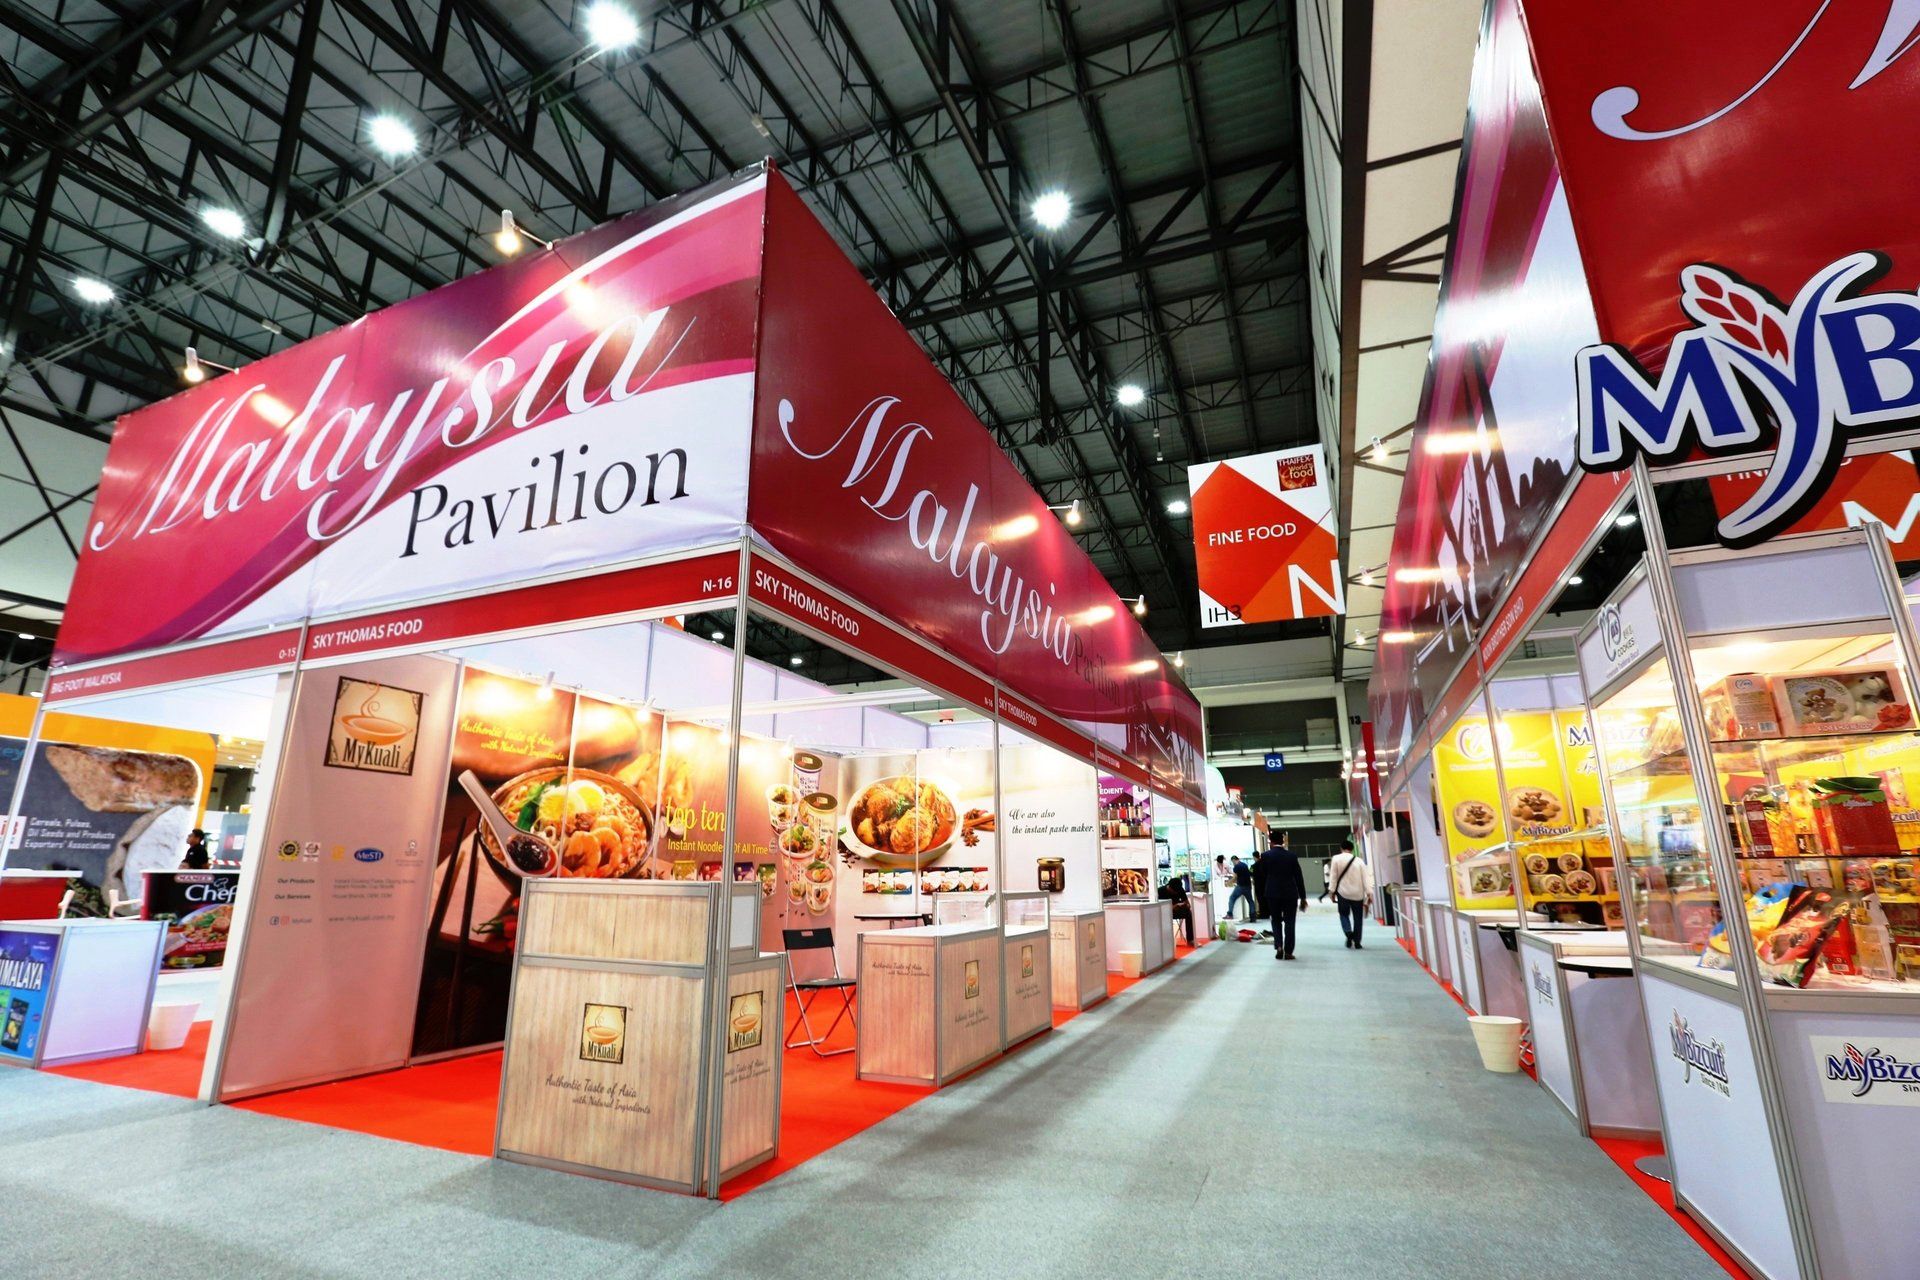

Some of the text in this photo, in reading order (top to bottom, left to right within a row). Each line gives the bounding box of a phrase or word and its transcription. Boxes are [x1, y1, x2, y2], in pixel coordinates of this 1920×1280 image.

[90, 305, 697, 552] Malaysia
[1290, 467, 1313, 479] food
[399, 444, 690, 559] Pavilion
[778, 395, 1074, 665] Malaysia
[1208, 522, 1297, 546] FINE FOOD
[702, 576, 732, 593] N-16
[1288, 559, 1346, 619] N
[755, 569, 859, 636] SKY THOMAS FOOD
[1208, 604, 1243, 623] IH3
[313, 618, 423, 650] SKY THOMAS FOOD
[51, 671, 122, 694] BIG FOOT MALAYSIA
[1007, 702, 1026, 721] THOMAS
[1025, 712, 1038, 727] FOOD
[343, 737, 401, 768] MyKuali
[1266, 758, 1282, 768] G3
[666, 796, 726, 841] top ten
[1009, 808, 1025, 820] We
[1041, 809, 1055, 818] also
[66, 830, 80, 838] and
[82, 830, 116, 839] Products
[1012, 823, 1094, 835] the instant paste maker.
[67, 840, 111, 849] Association
[668, 839, 696, 851] Instant
[697, 841, 725, 852] Noodle
[742, 844, 751, 853] All
[752, 844, 769, 855] Time
[587, 1040, 616, 1059] MyKuali
[546, 1073, 637, 1098] Authentic Taste of Asia
[572, 1095, 651, 1114] with Natural Ingredients
